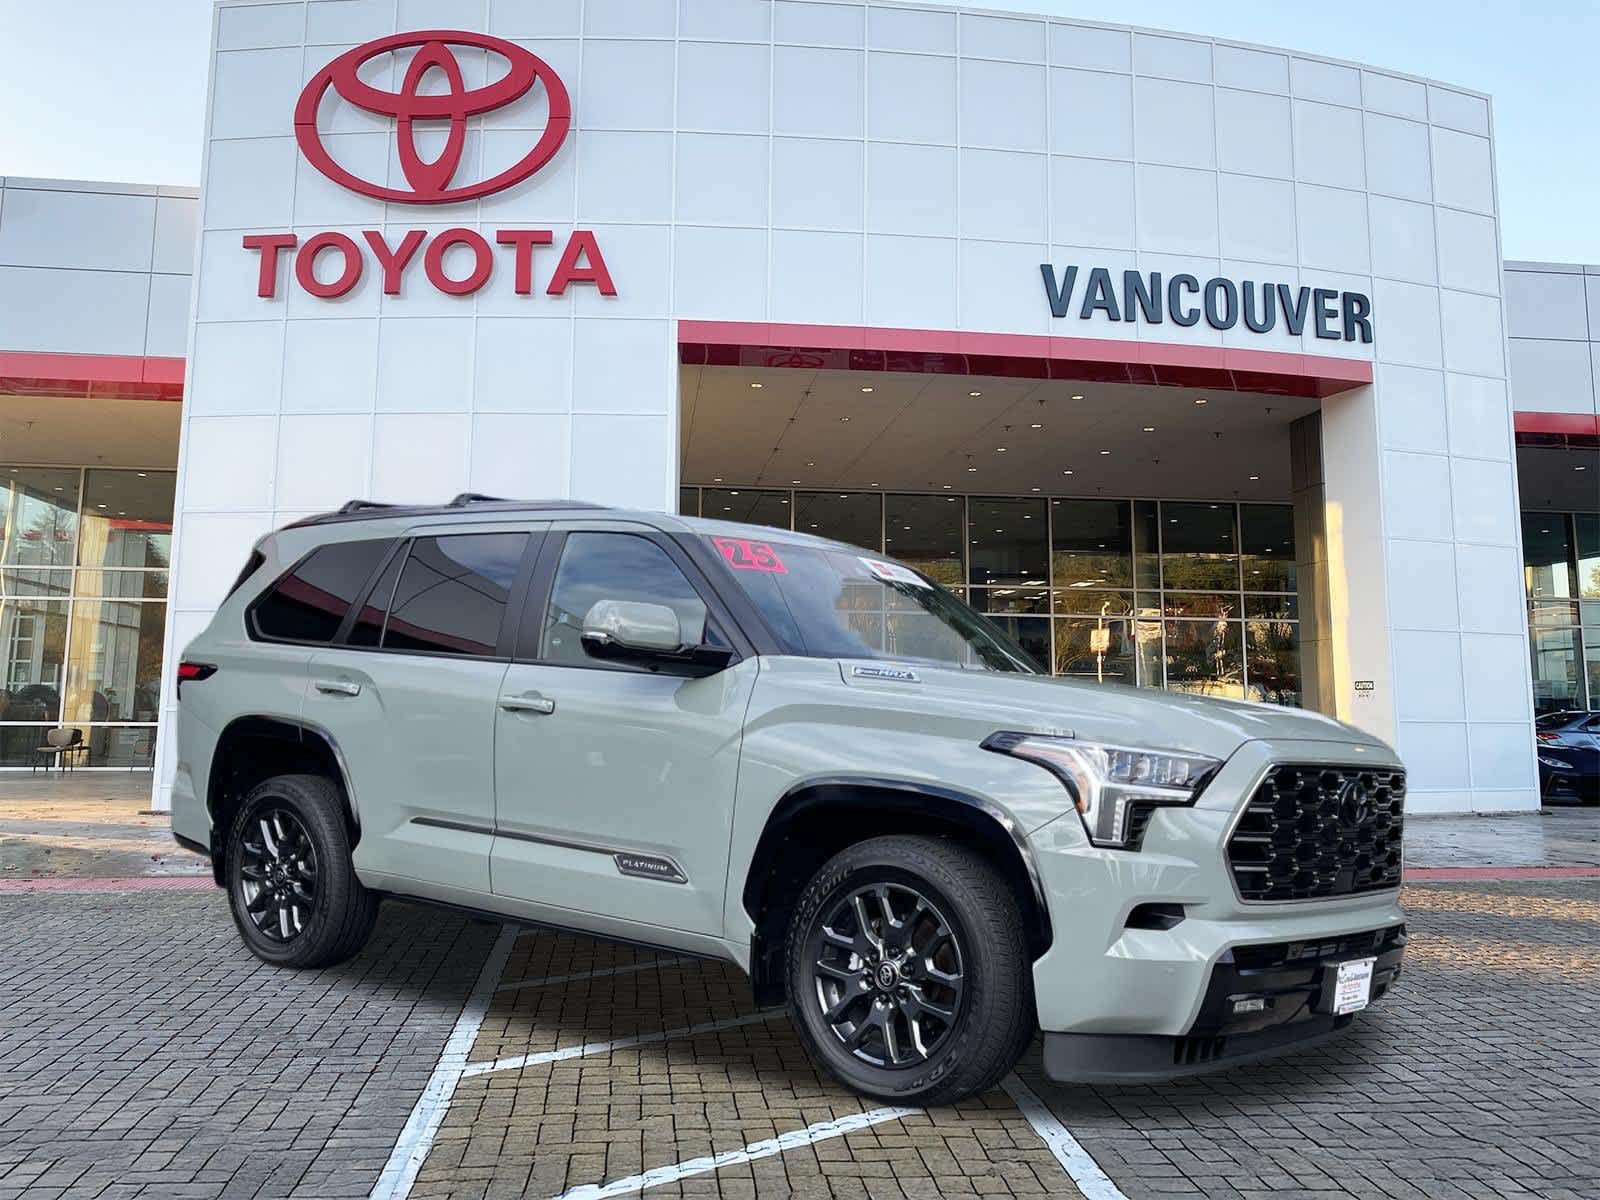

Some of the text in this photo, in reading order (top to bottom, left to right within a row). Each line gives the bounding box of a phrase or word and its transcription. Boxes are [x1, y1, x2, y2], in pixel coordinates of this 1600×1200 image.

[243, 228, 617, 298] TOYOTA
[1040, 264, 1373, 344] VANCOUVER
[723, 542, 777, 567] 25
[622, 859, 668, 871] PLATINUM
